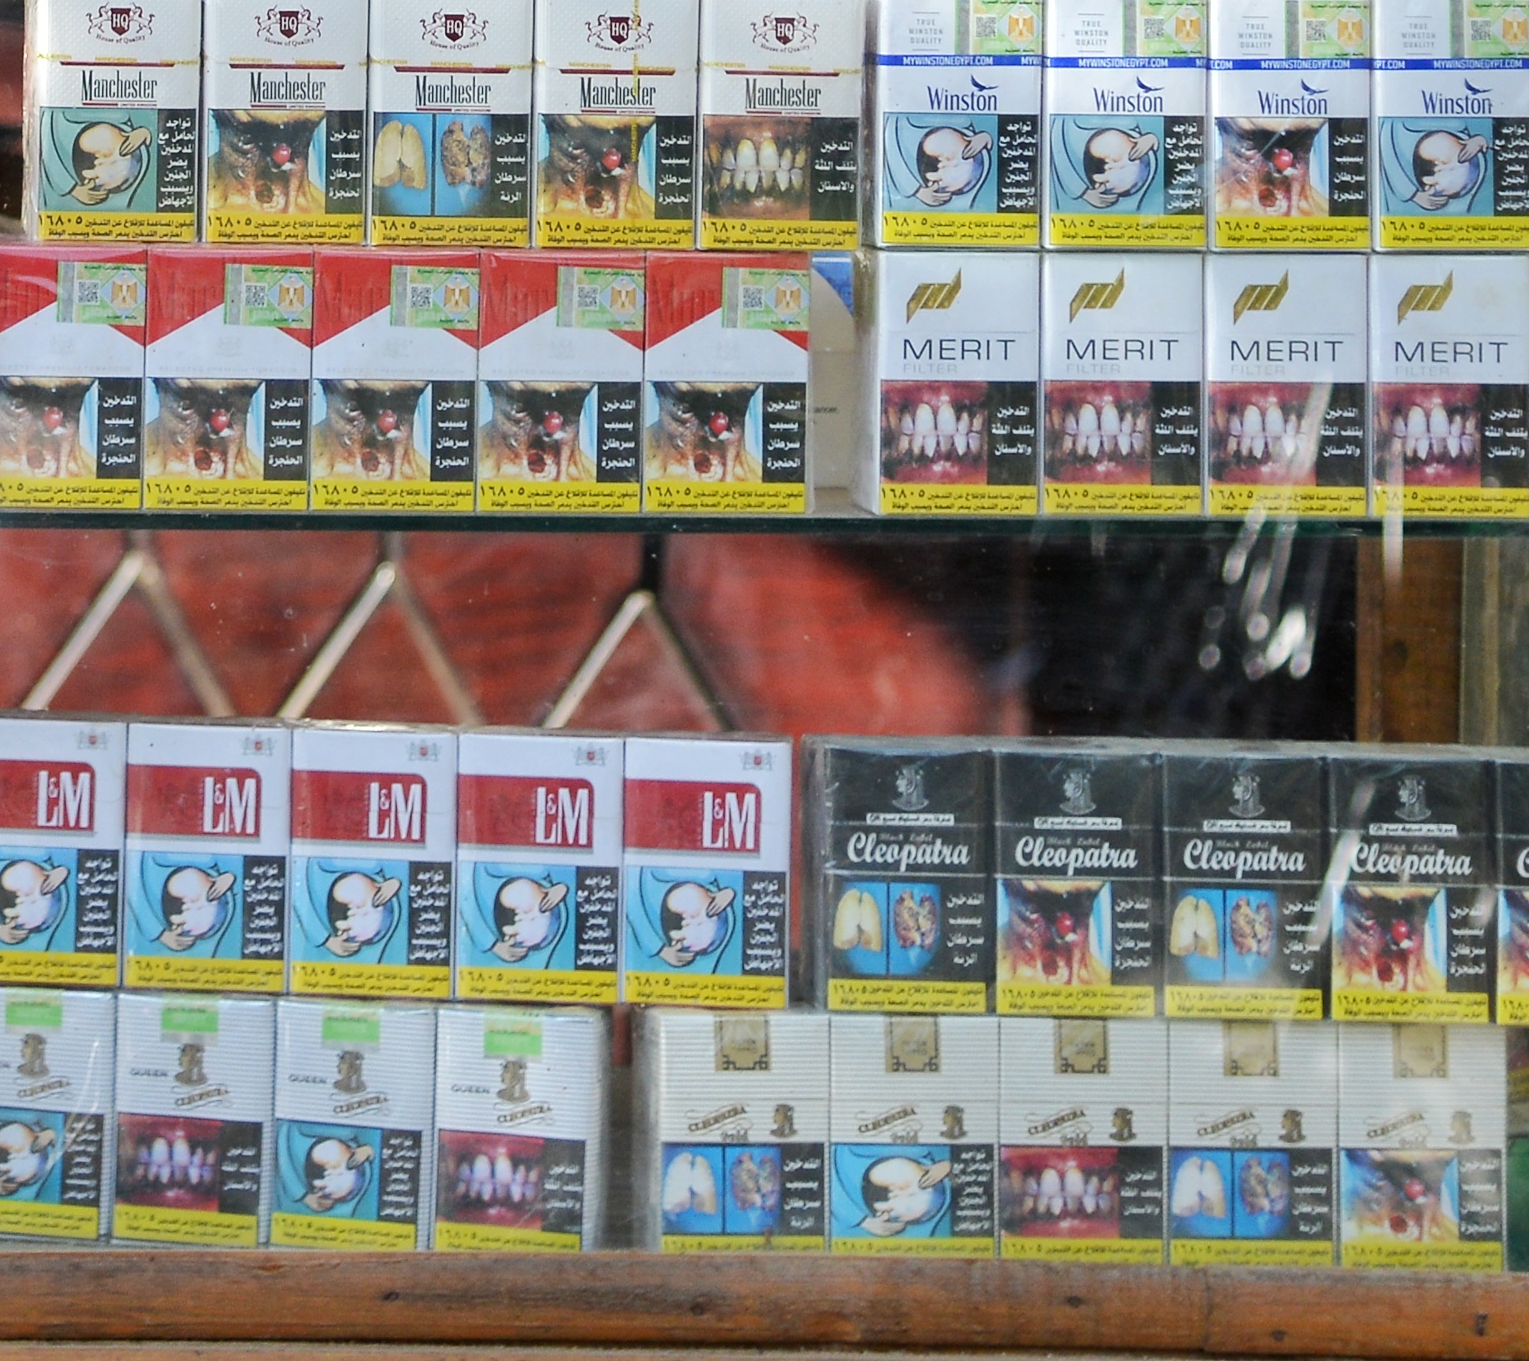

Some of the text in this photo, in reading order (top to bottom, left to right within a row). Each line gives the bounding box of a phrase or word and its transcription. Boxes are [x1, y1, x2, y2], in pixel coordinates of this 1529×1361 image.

[112, 14, 130, 29] HQ
[281, 16, 298, 31] HQ
[447, 19, 464, 34] HQ
[916, 18, 936, 27] TRUE
[610, 21, 628, 38] HQ
[776, 23, 795, 38] HQ
[908, 28, 944, 36] WINSTON
[910, 37, 943, 46] QUALITY
[903, 56, 994, 67] MYWINSTONEGYPT.COM
[1078, 57, 1169, 69] MYWINSTONEGYPT.COM
[1261, 59, 1351, 71] MYWINSTONEGYPT.COM
[1434, 59, 1523, 70] MYWINSTONEGYPT.COM
[81, 70, 158, 102] Manchester
[250, 72, 326, 104] Manchester
[416, 76, 492, 106] Manchester
[580, 77, 657, 109] Manchester
[745, 78, 822, 110] Manchester
[927, 85, 998, 113] Winston
[1093, 86, 1164, 114] Winston
[1258, 89, 1328, 115] Winston
[1422, 89, 1492, 116] Winston
[902, 338, 1017, 361] MERIT
[1066, 338, 1180, 362] MERIT
[1230, 339, 1344, 363] MERIT
[1395, 340, 1509, 364] MERIT
[903, 363, 958, 375] FILTER
[1066, 363, 1121, 375] FILTER
[103, 394, 137, 409] التدخين
[269, 396, 304, 410] التدخين
[436, 397, 470, 412] التدخين
[766, 398, 801, 412] التدخين
[997, 405, 1030, 419] التدخين
[104, 416, 134, 427] يسبب
[271, 417, 301, 428] يسبب
[437, 419, 468, 430] يسبب
[768, 420, 798, 432] يسبب
[102, 433, 136, 446] سرطان
[269, 435, 303, 448] سرطان
[435, 437, 470, 449] سرطان
[766, 438, 800, 451] سرطان
[101, 452, 137, 466] الحنجرة
[268, 453, 303, 468] الحنجرة
[434, 455, 470, 470] الحنجرة
[766, 456, 801, 471] الحنجرة
[146, 482, 192, 494] ١٦٨٠٥
[313, 482, 359, 495] ١٦٨٠٥
[480, 485, 525, 497] ١٦٨٠٥
[647, 485, 692, 497] ١٦٨٠٥
[37, 769, 92, 829] L&M
[202, 776, 258, 835] L&M
[367, 780, 423, 842] L&M
[535, 785, 590, 846] L&M
[701, 790, 757, 851] L&M
[847, 832, 971, 873] Cleopatra
[1014, 835, 1139, 877] Cleopatra
[1182, 837, 1307, 881] Cleopatra
[1351, 843, 1473, 884] Cleopatra
